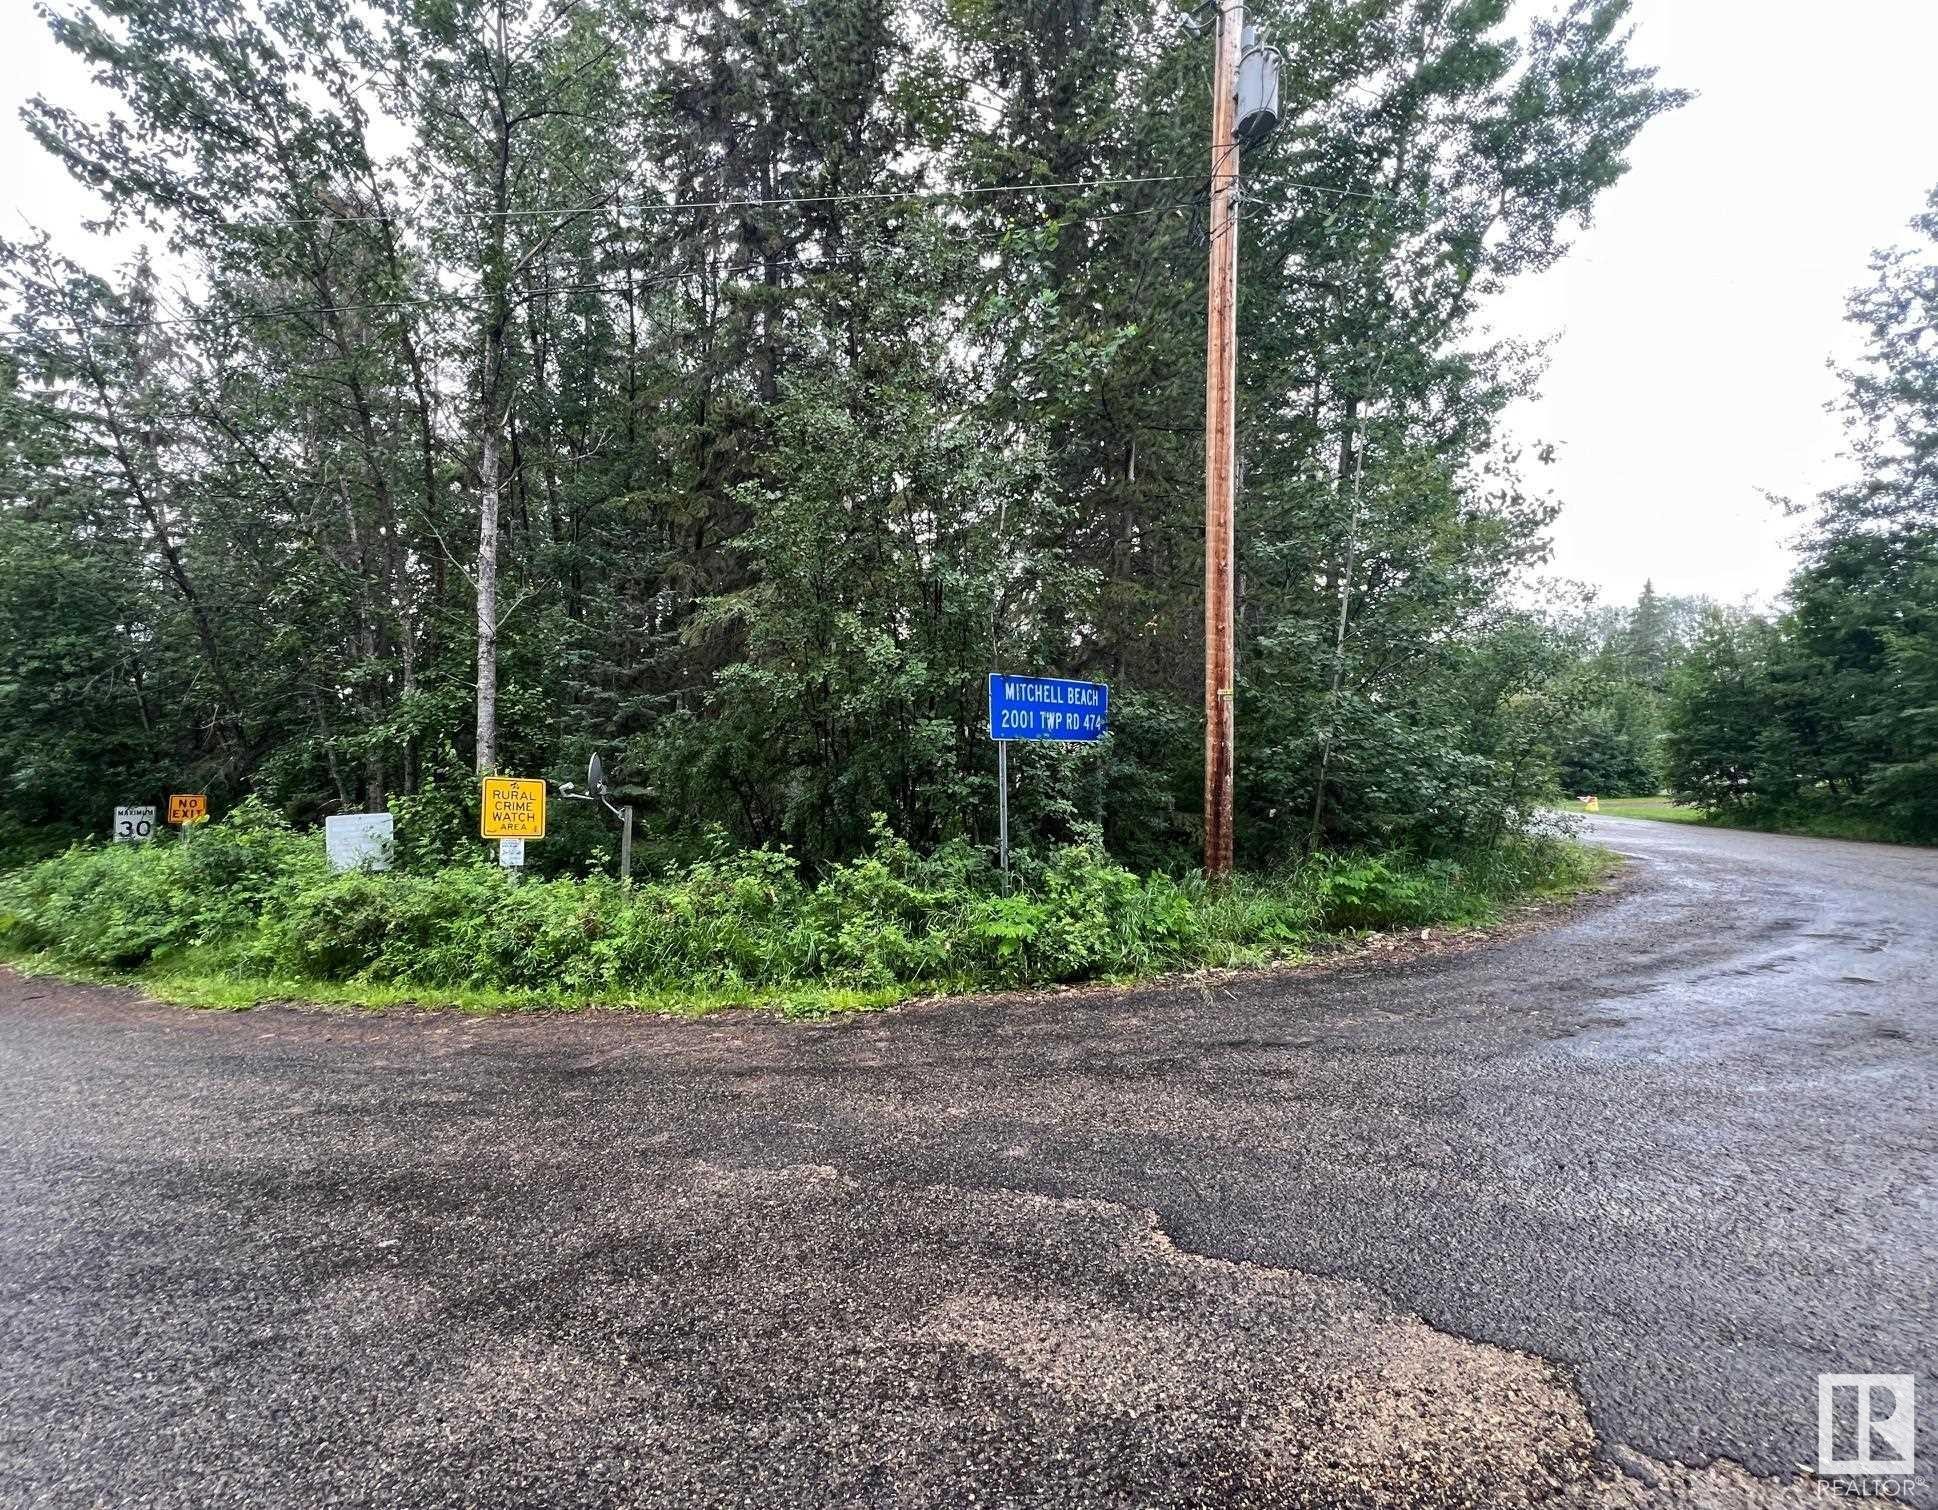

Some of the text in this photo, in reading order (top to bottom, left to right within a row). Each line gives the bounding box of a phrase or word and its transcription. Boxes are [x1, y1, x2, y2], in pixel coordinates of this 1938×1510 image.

[1005, 682, 1099, 706] MITCHELL BEACH
[1001, 710, 1034, 729] 2001
[1040, 711, 1063, 730] TWP
[1066, 713, 1080, 730] RD
[492, 790, 537, 801] RURAL
[178, 799, 198, 808] NO
[495, 801, 533, 812] CRIME
[172, 809, 204, 818] EXIT
[492, 812, 535, 823] WATCH
[119, 820, 151, 837] 30
[501, 823, 527, 831] AREA
